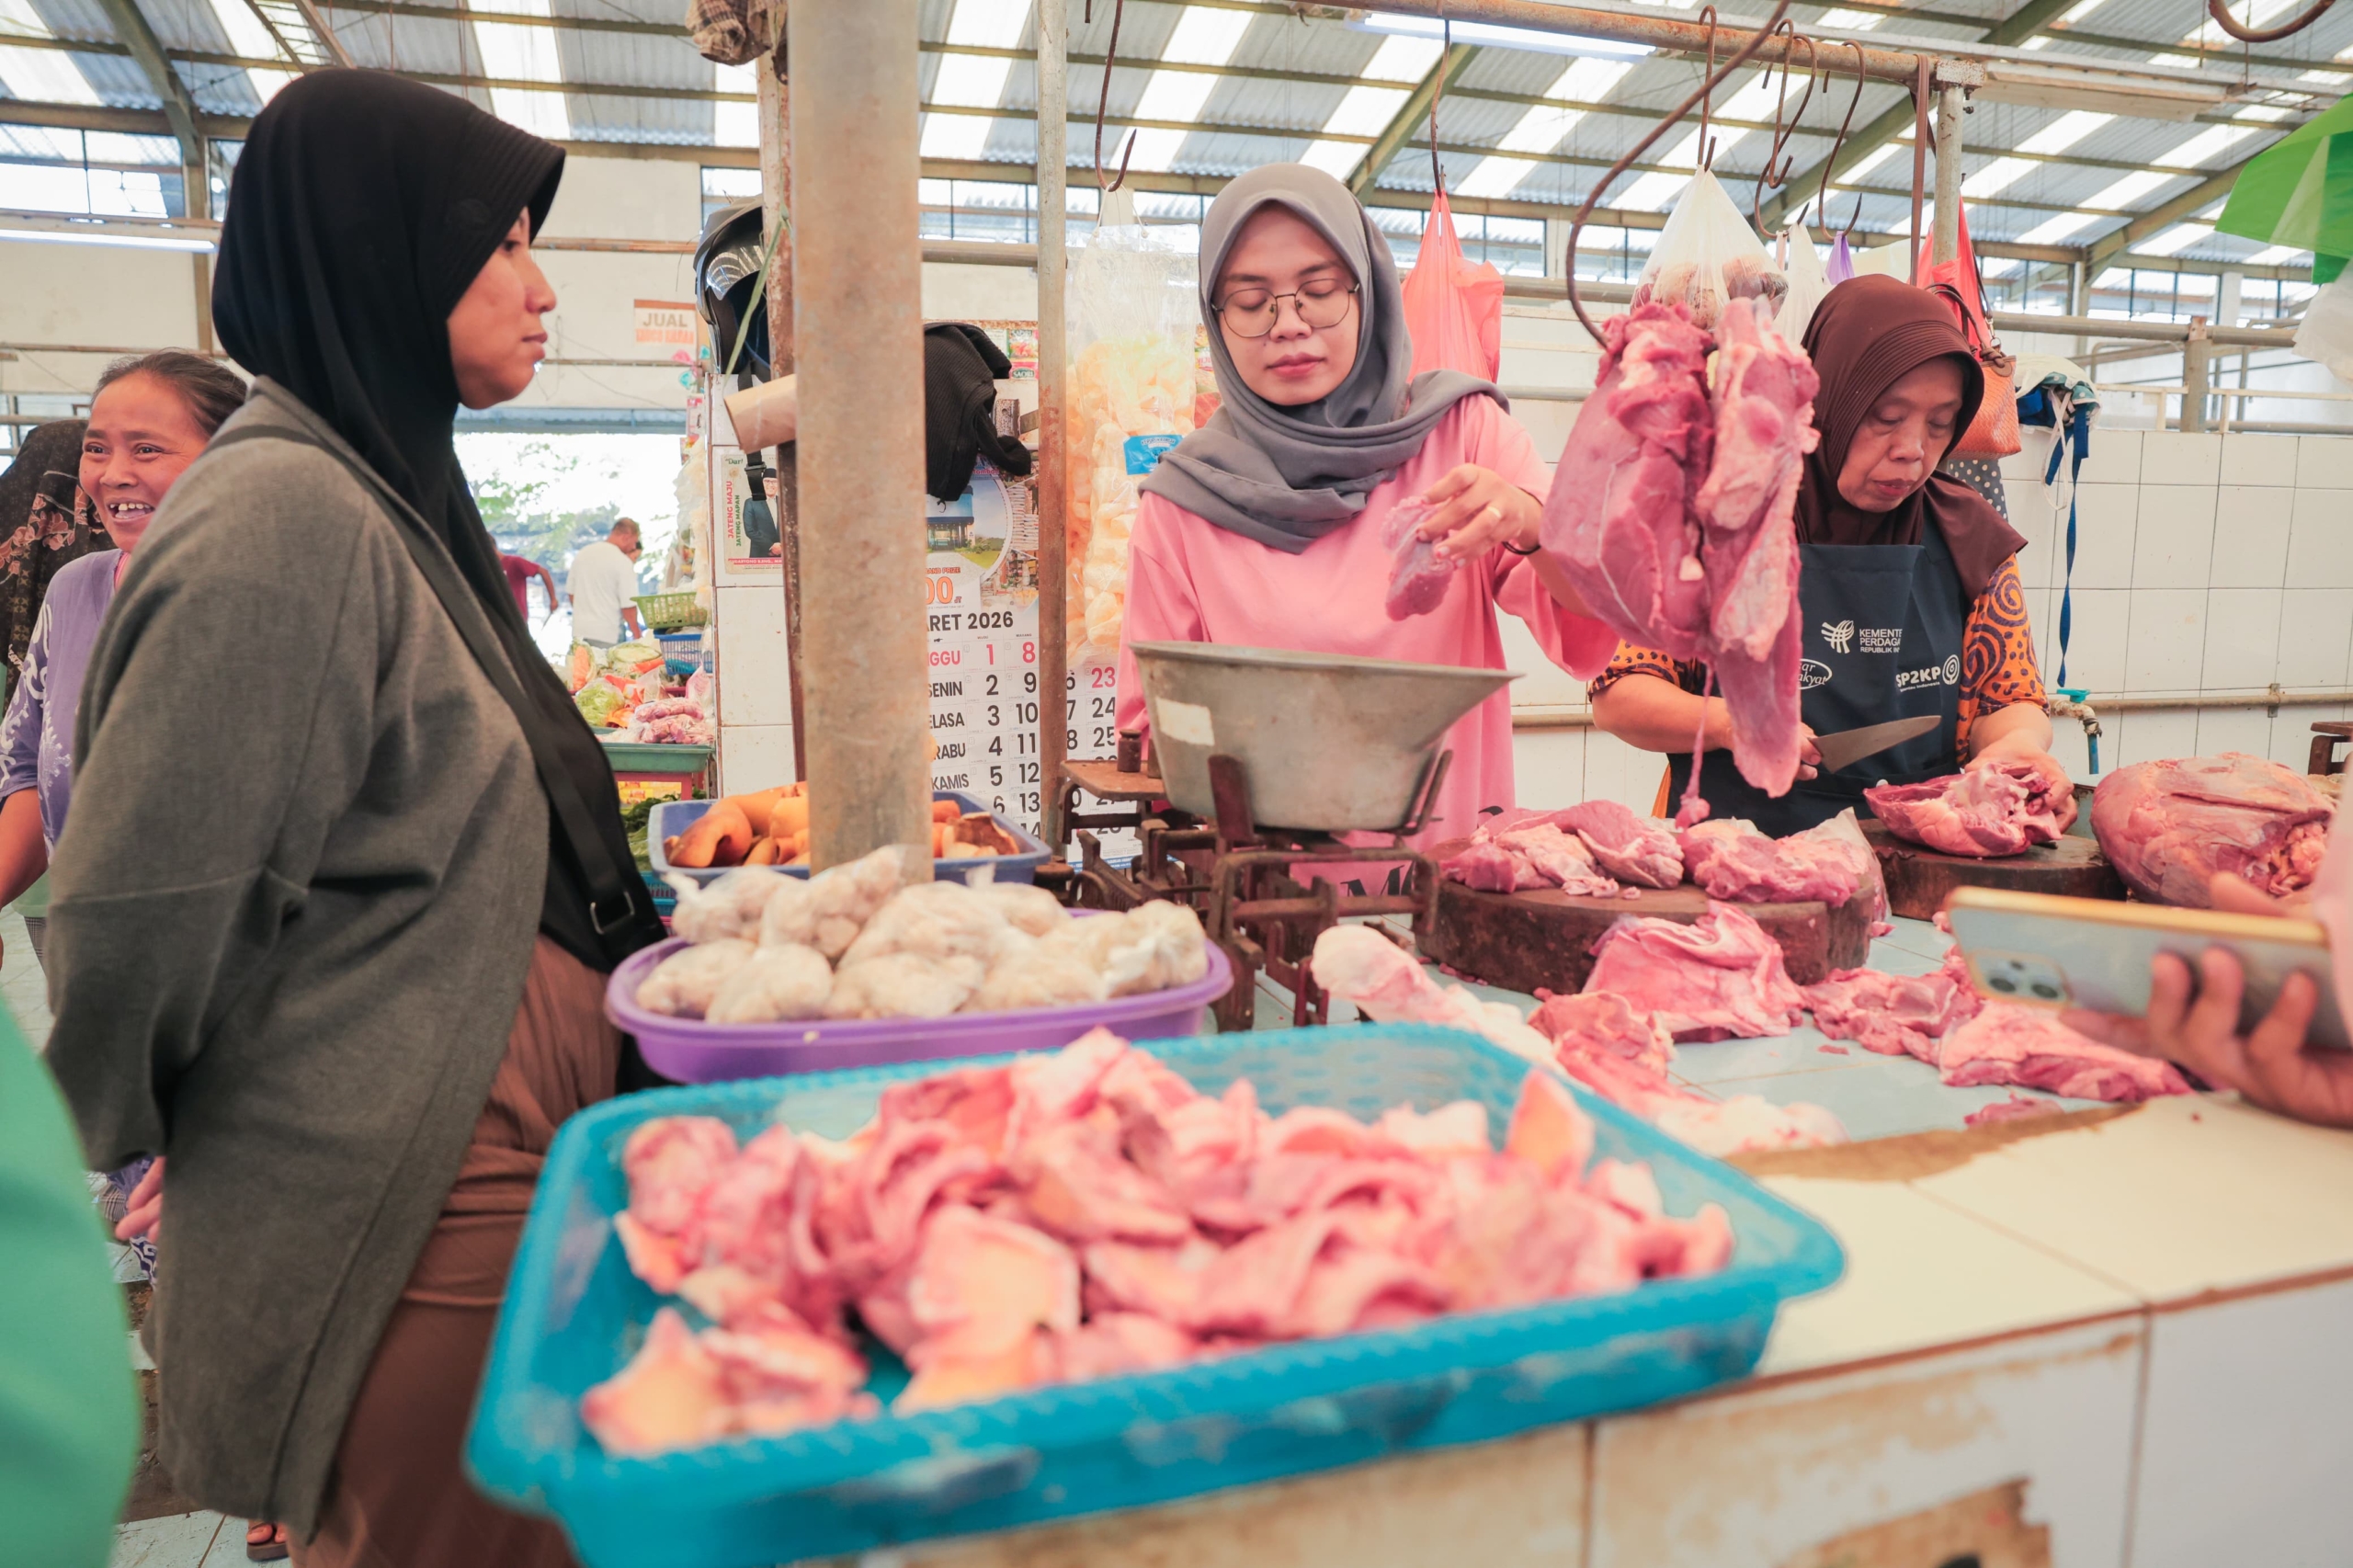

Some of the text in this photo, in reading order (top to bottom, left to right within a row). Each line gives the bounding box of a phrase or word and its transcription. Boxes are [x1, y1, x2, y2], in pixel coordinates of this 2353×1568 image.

[642, 312, 688, 327] JUAL
[926, 610, 1014, 632] RET 2026
[927, 642, 1036, 666] GGU 1 8
[986, 674, 999, 696] 2
[1023, 672, 1037, 693] 9
[1091, 666, 1116, 688] 23
[1895, 665, 1941, 687] SP2KP
[987, 705, 1000, 726] 3
[1016, 702, 1039, 724] 10
[1091, 697, 1116, 718] 24
[988, 736, 1003, 756] 4
[1017, 733, 1036, 755] 11
[1093, 726, 1116, 747] 25
[931, 762, 1040, 790] KAMIS 5 12
[993, 795, 1006, 813] 6
[1019, 791, 1040, 813] 13
